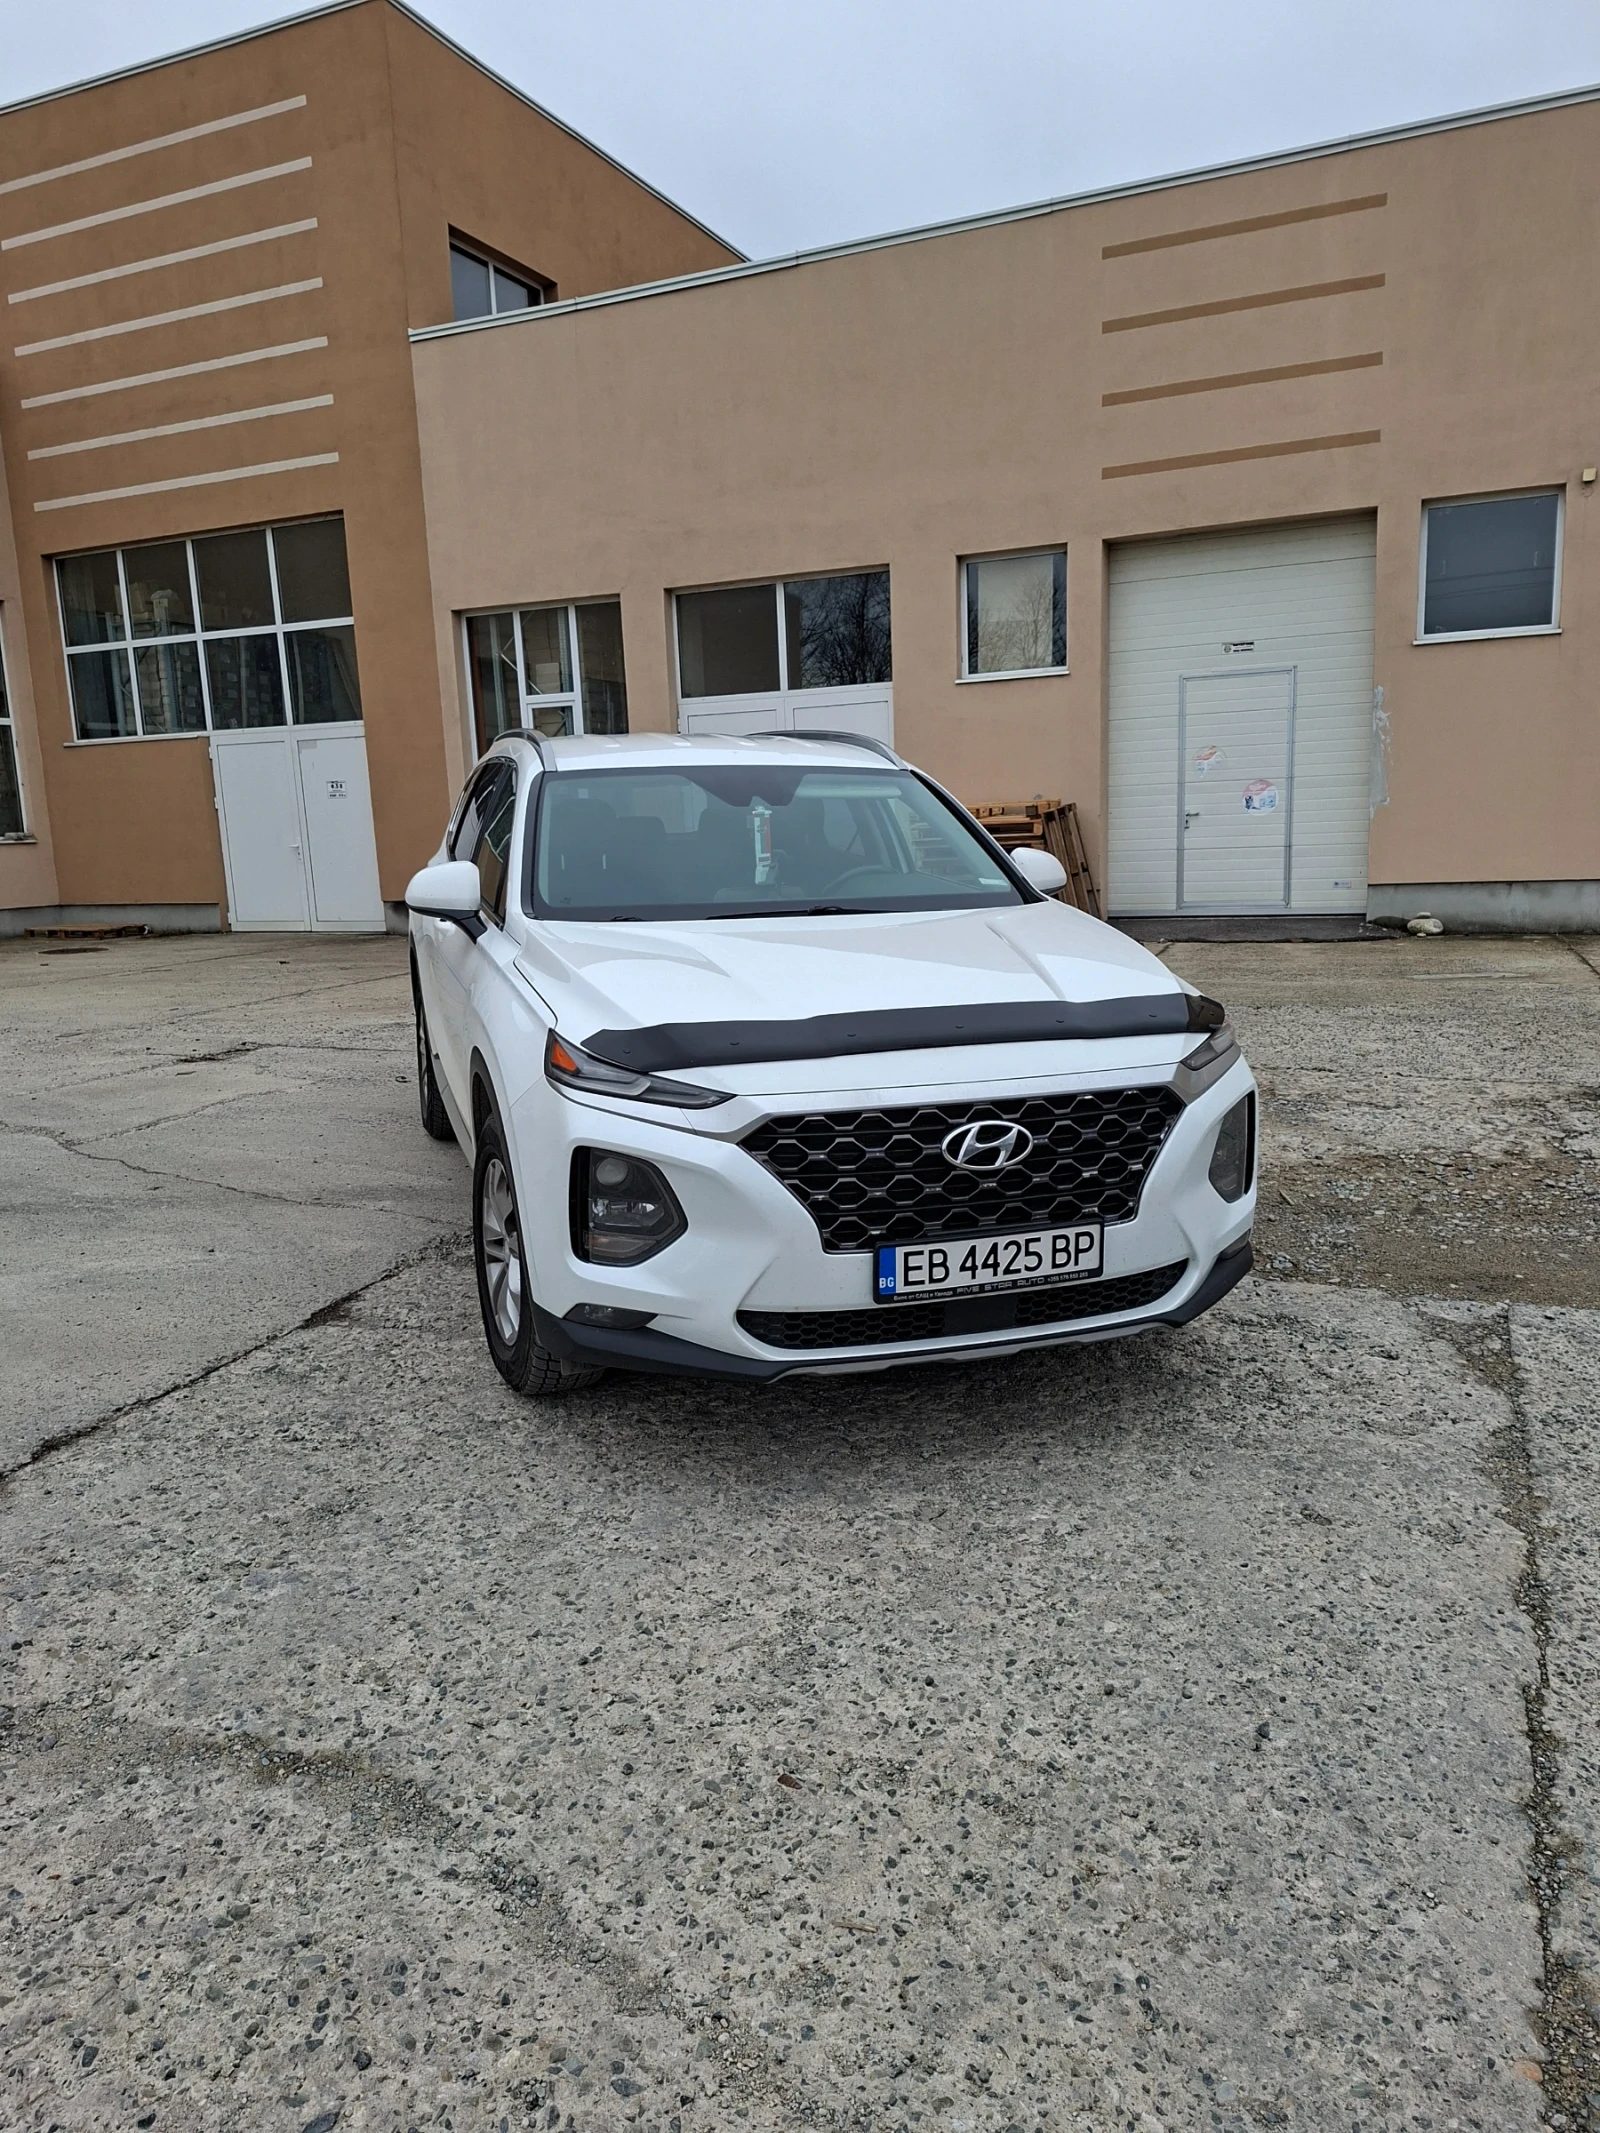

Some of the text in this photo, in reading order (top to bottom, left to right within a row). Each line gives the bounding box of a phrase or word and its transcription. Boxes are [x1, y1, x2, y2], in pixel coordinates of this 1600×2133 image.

[903, 1231, 1095, 1287] EB 4425 BP
[879, 1277, 895, 1289] BG
[956, 1277, 1045, 1294] FIVE STAR AUTO
